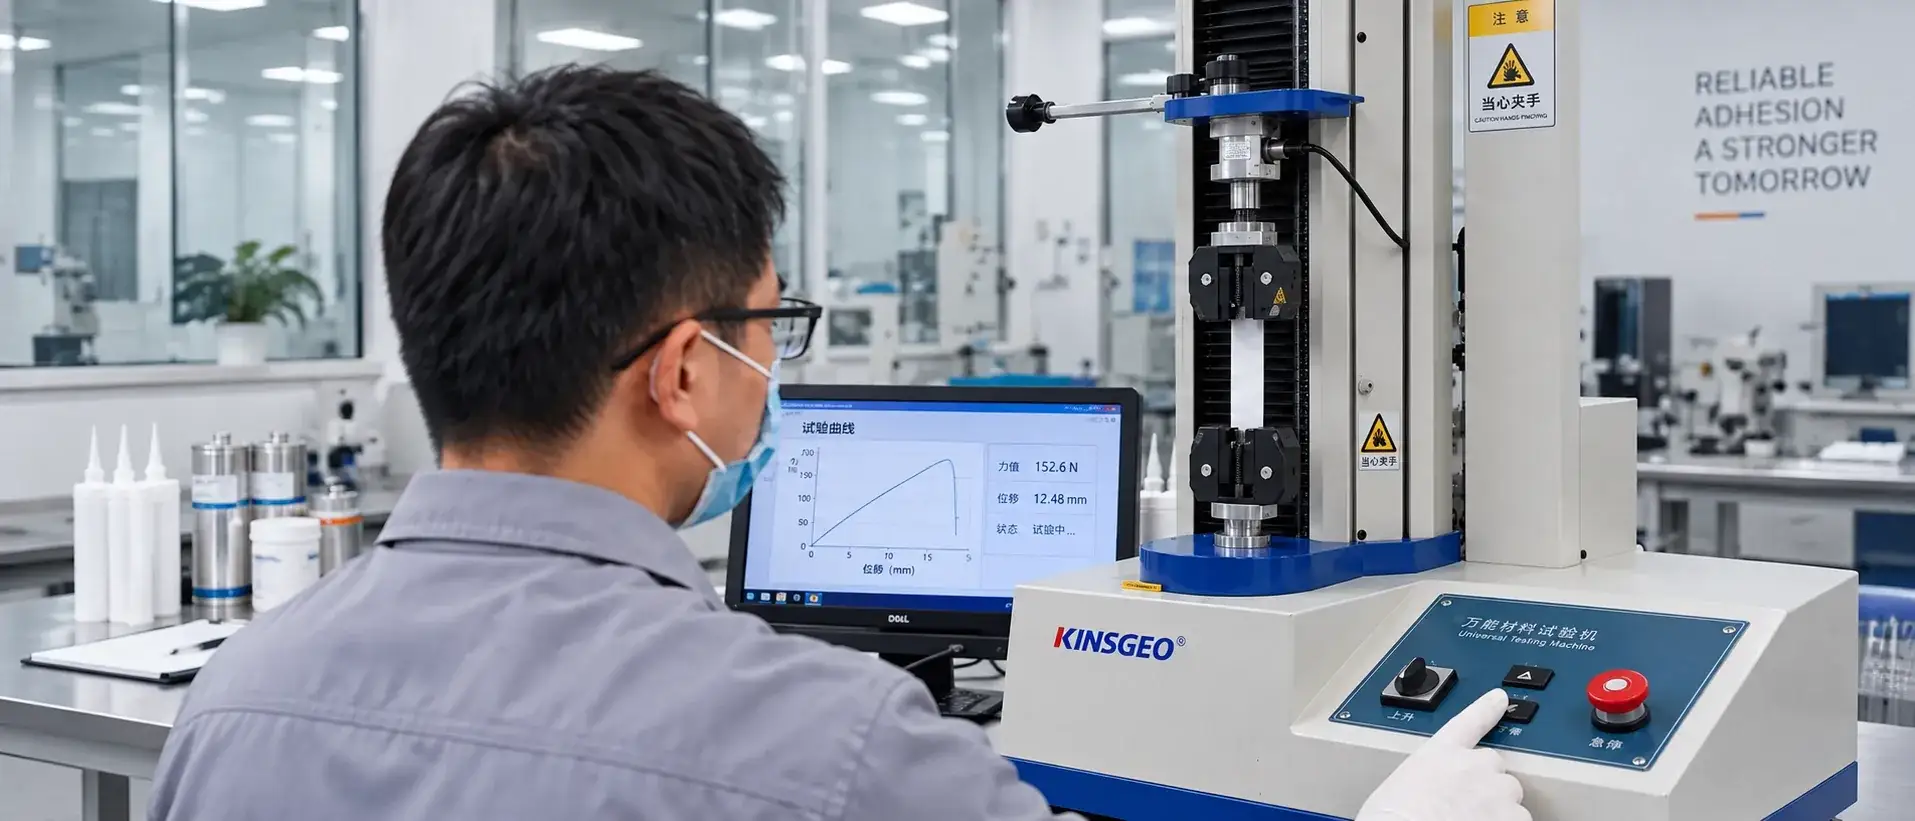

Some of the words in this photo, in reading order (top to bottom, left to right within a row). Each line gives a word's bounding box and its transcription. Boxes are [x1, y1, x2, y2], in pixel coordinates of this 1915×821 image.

[1493, 9, 1528, 25] 注意
[1695, 62, 1834, 94] RELIABLE
[1482, 93, 1540, 111] 当心夹手
[1695, 96, 1844, 128] ADHESION
[1695, 138, 1713, 161] A
[1721, 129, 1877, 161] STRONGER
[1695, 164, 1871, 195] TOMORROW
[802, 421, 855, 435] 试验曲线
[998, 461, 1020, 472] 力值
[1035, 461, 1066, 472] 152.6
[1069, 462, 1078, 472] N
[1361, 456, 1397, 467] 当心夹手
[798, 494, 811, 502] 100
[1034, 494, 1065, 504] 12.48
[1067, 496, 1087, 504] mm
[884, 552, 894, 560] 10
[1461, 616, 1598, 641] 万能材料试验机
[1458, 630, 1508, 642] Universal
[1510, 635, 1547, 647] Testing
[1549, 640, 1596, 651] Machine
[1387, 711, 1415, 722] 上升
